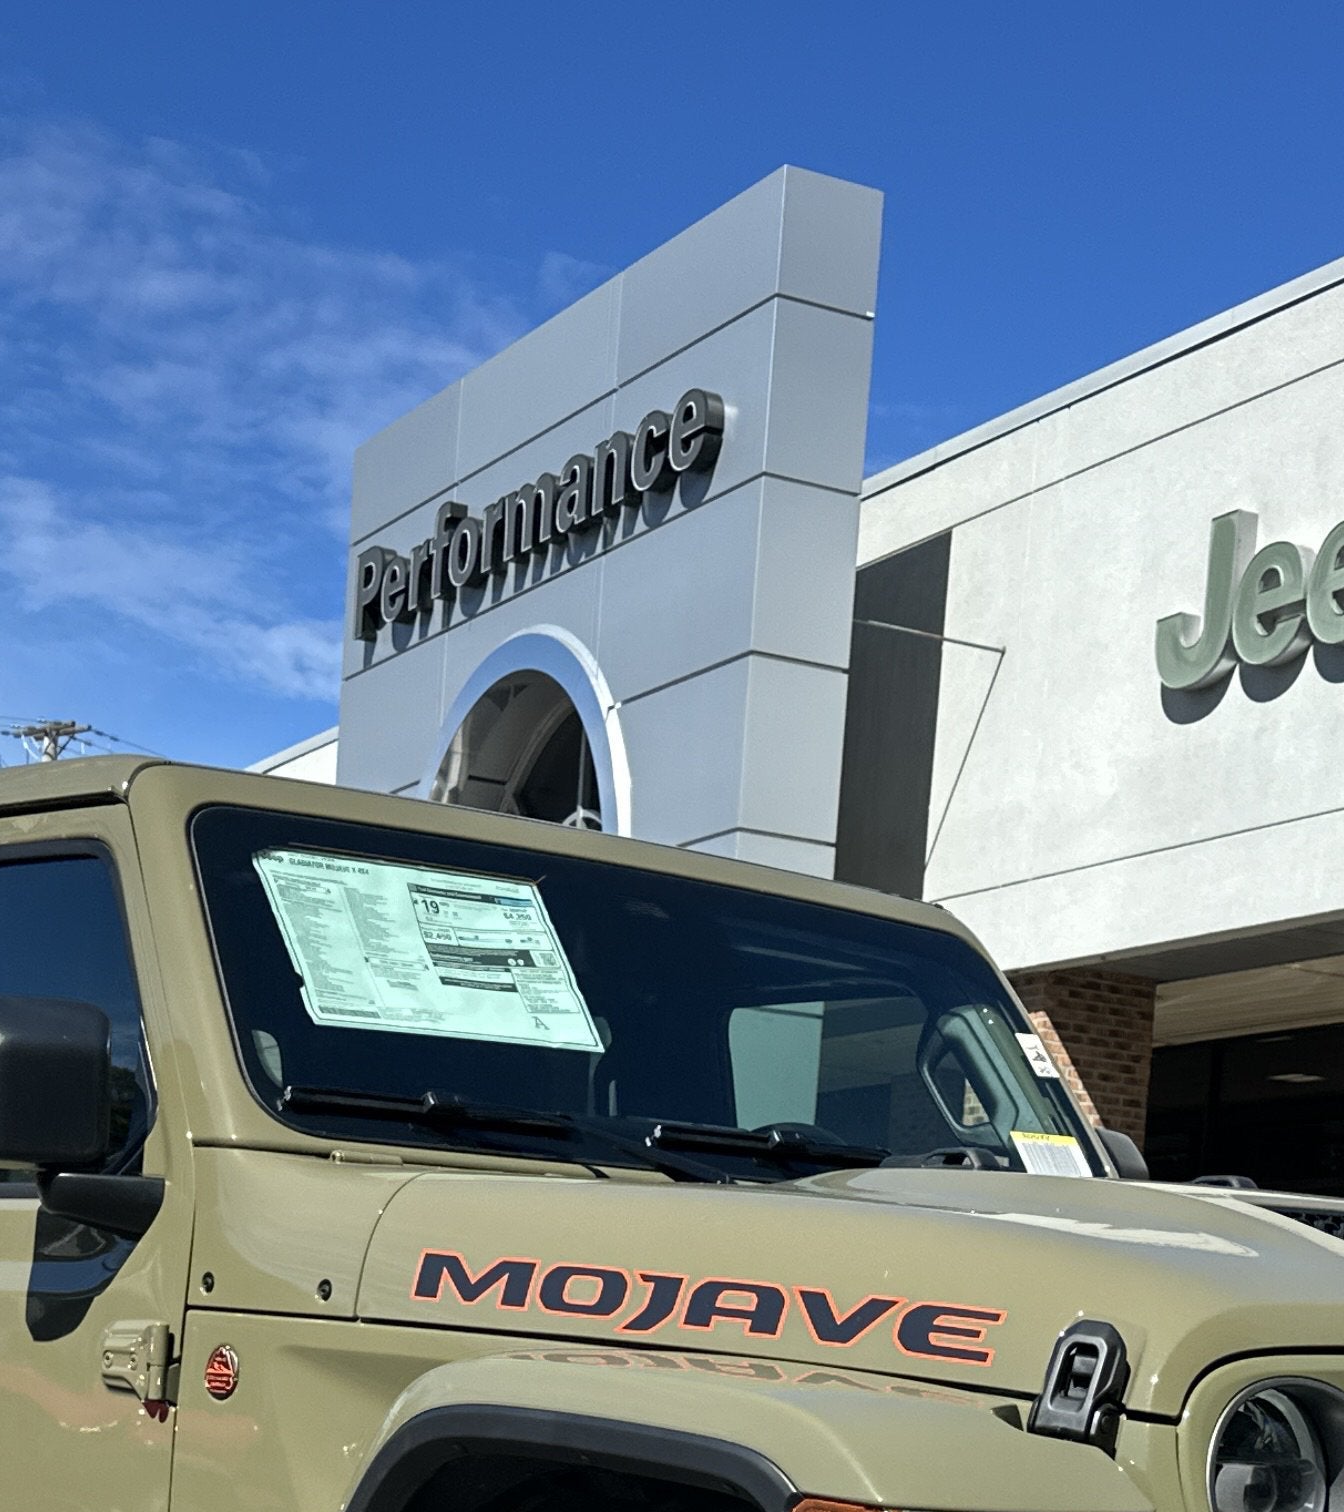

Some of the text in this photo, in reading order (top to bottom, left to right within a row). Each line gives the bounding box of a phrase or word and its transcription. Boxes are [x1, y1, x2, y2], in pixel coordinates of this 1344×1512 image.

[353, 387, 725, 641] Performance
[421, 898, 440, 914] 19
[410, 1248, 1008, 1367] MOJAVE
